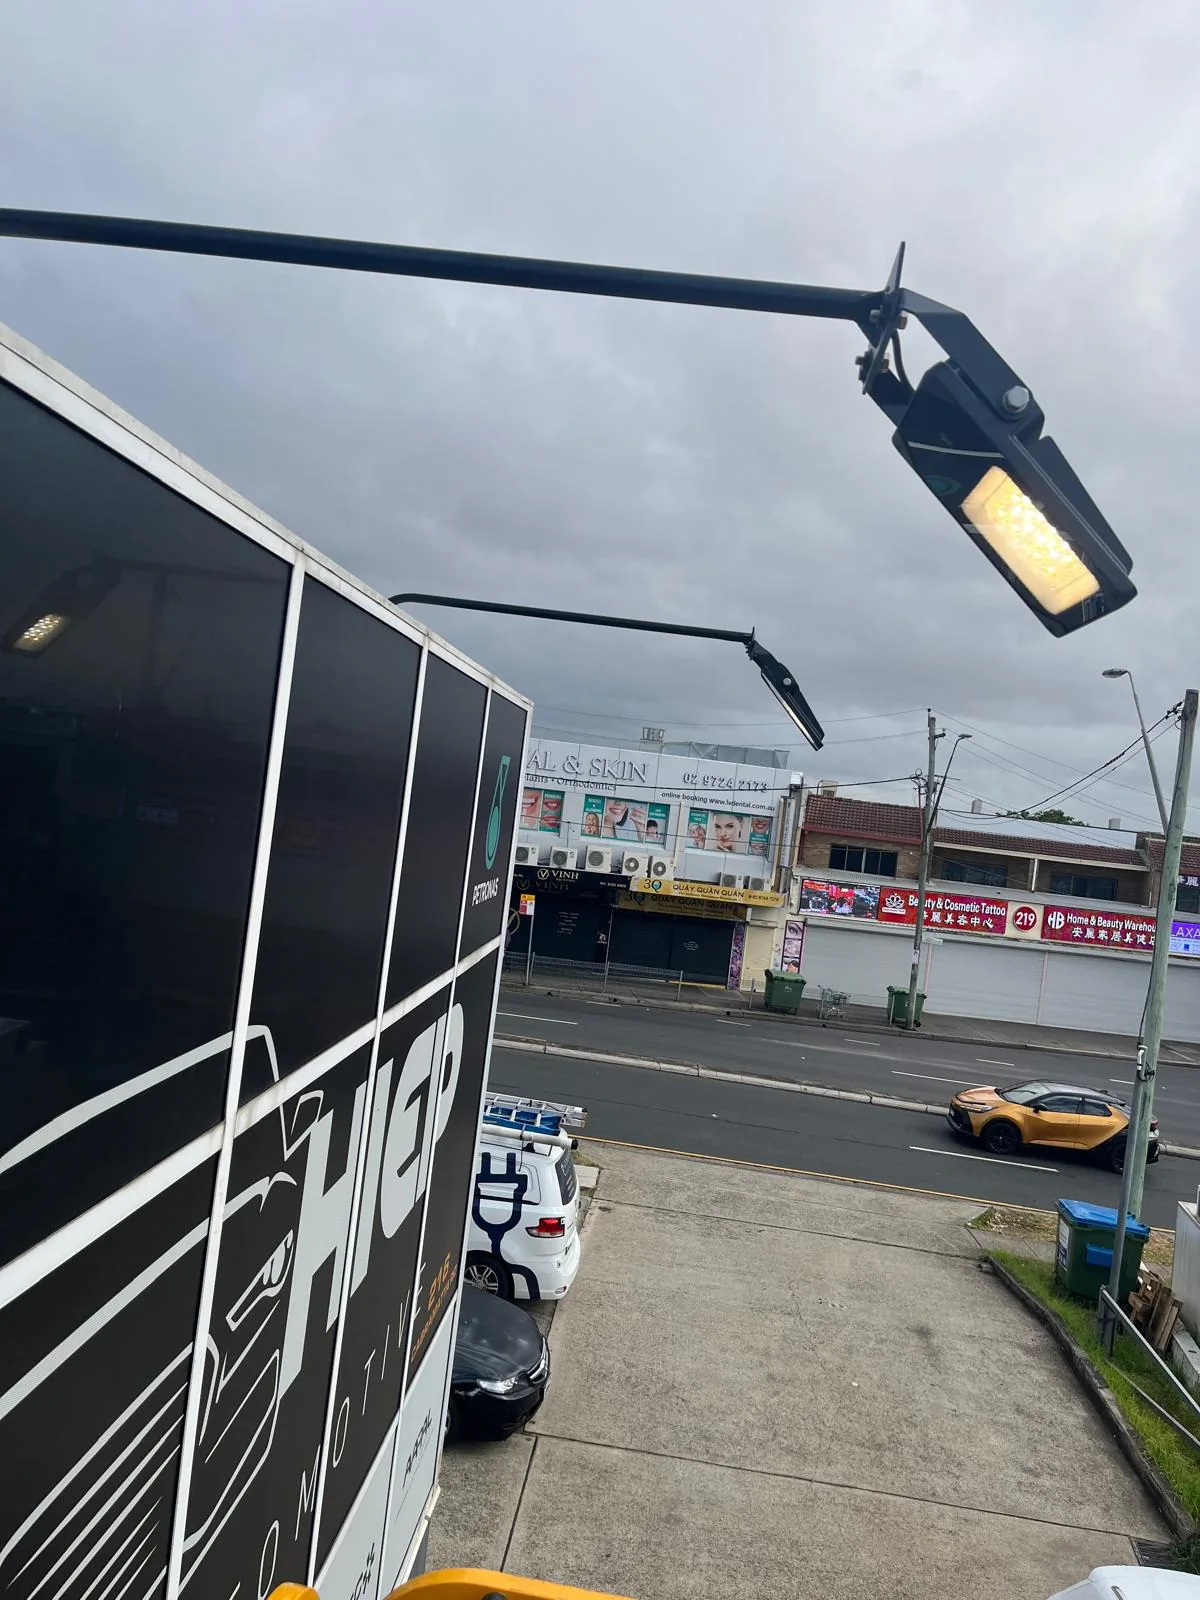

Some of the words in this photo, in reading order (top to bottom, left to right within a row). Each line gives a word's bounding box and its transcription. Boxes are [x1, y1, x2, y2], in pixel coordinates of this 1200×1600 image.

[563, 753, 584, 775] &
[589, 758, 647, 783] SKIN
[524, 774, 549, 784] lants
[557, 777, 617, 791] Orthodontics
[683, 772, 698, 785] 02
[703, 775, 732, 789] 9724
[661, 791, 680, 800] online
[682, 792, 708, 804] booking
[709, 799, 775, 811] www.lvdental.com.au
[551, 869, 580, 880] VINH
[472, 877, 499, 906] PETRONAS
[908, 894, 936, 909] Beuty
[936, 897, 943, 909] &
[944, 898, 980, 913] Cosmetic
[981, 902, 1006, 916] Tattoo
[1015, 911, 1036, 927] 219
[1048, 911, 1065, 929] HB
[1067, 912, 1088, 925] Home
[1090, 914, 1096, 925] &
[1097, 916, 1124, 931] Beauty
[1170, 926, 1200, 938] AXA
[279, 1002, 464, 1400] HIEP
[427, 1252, 451, 1311] 216
